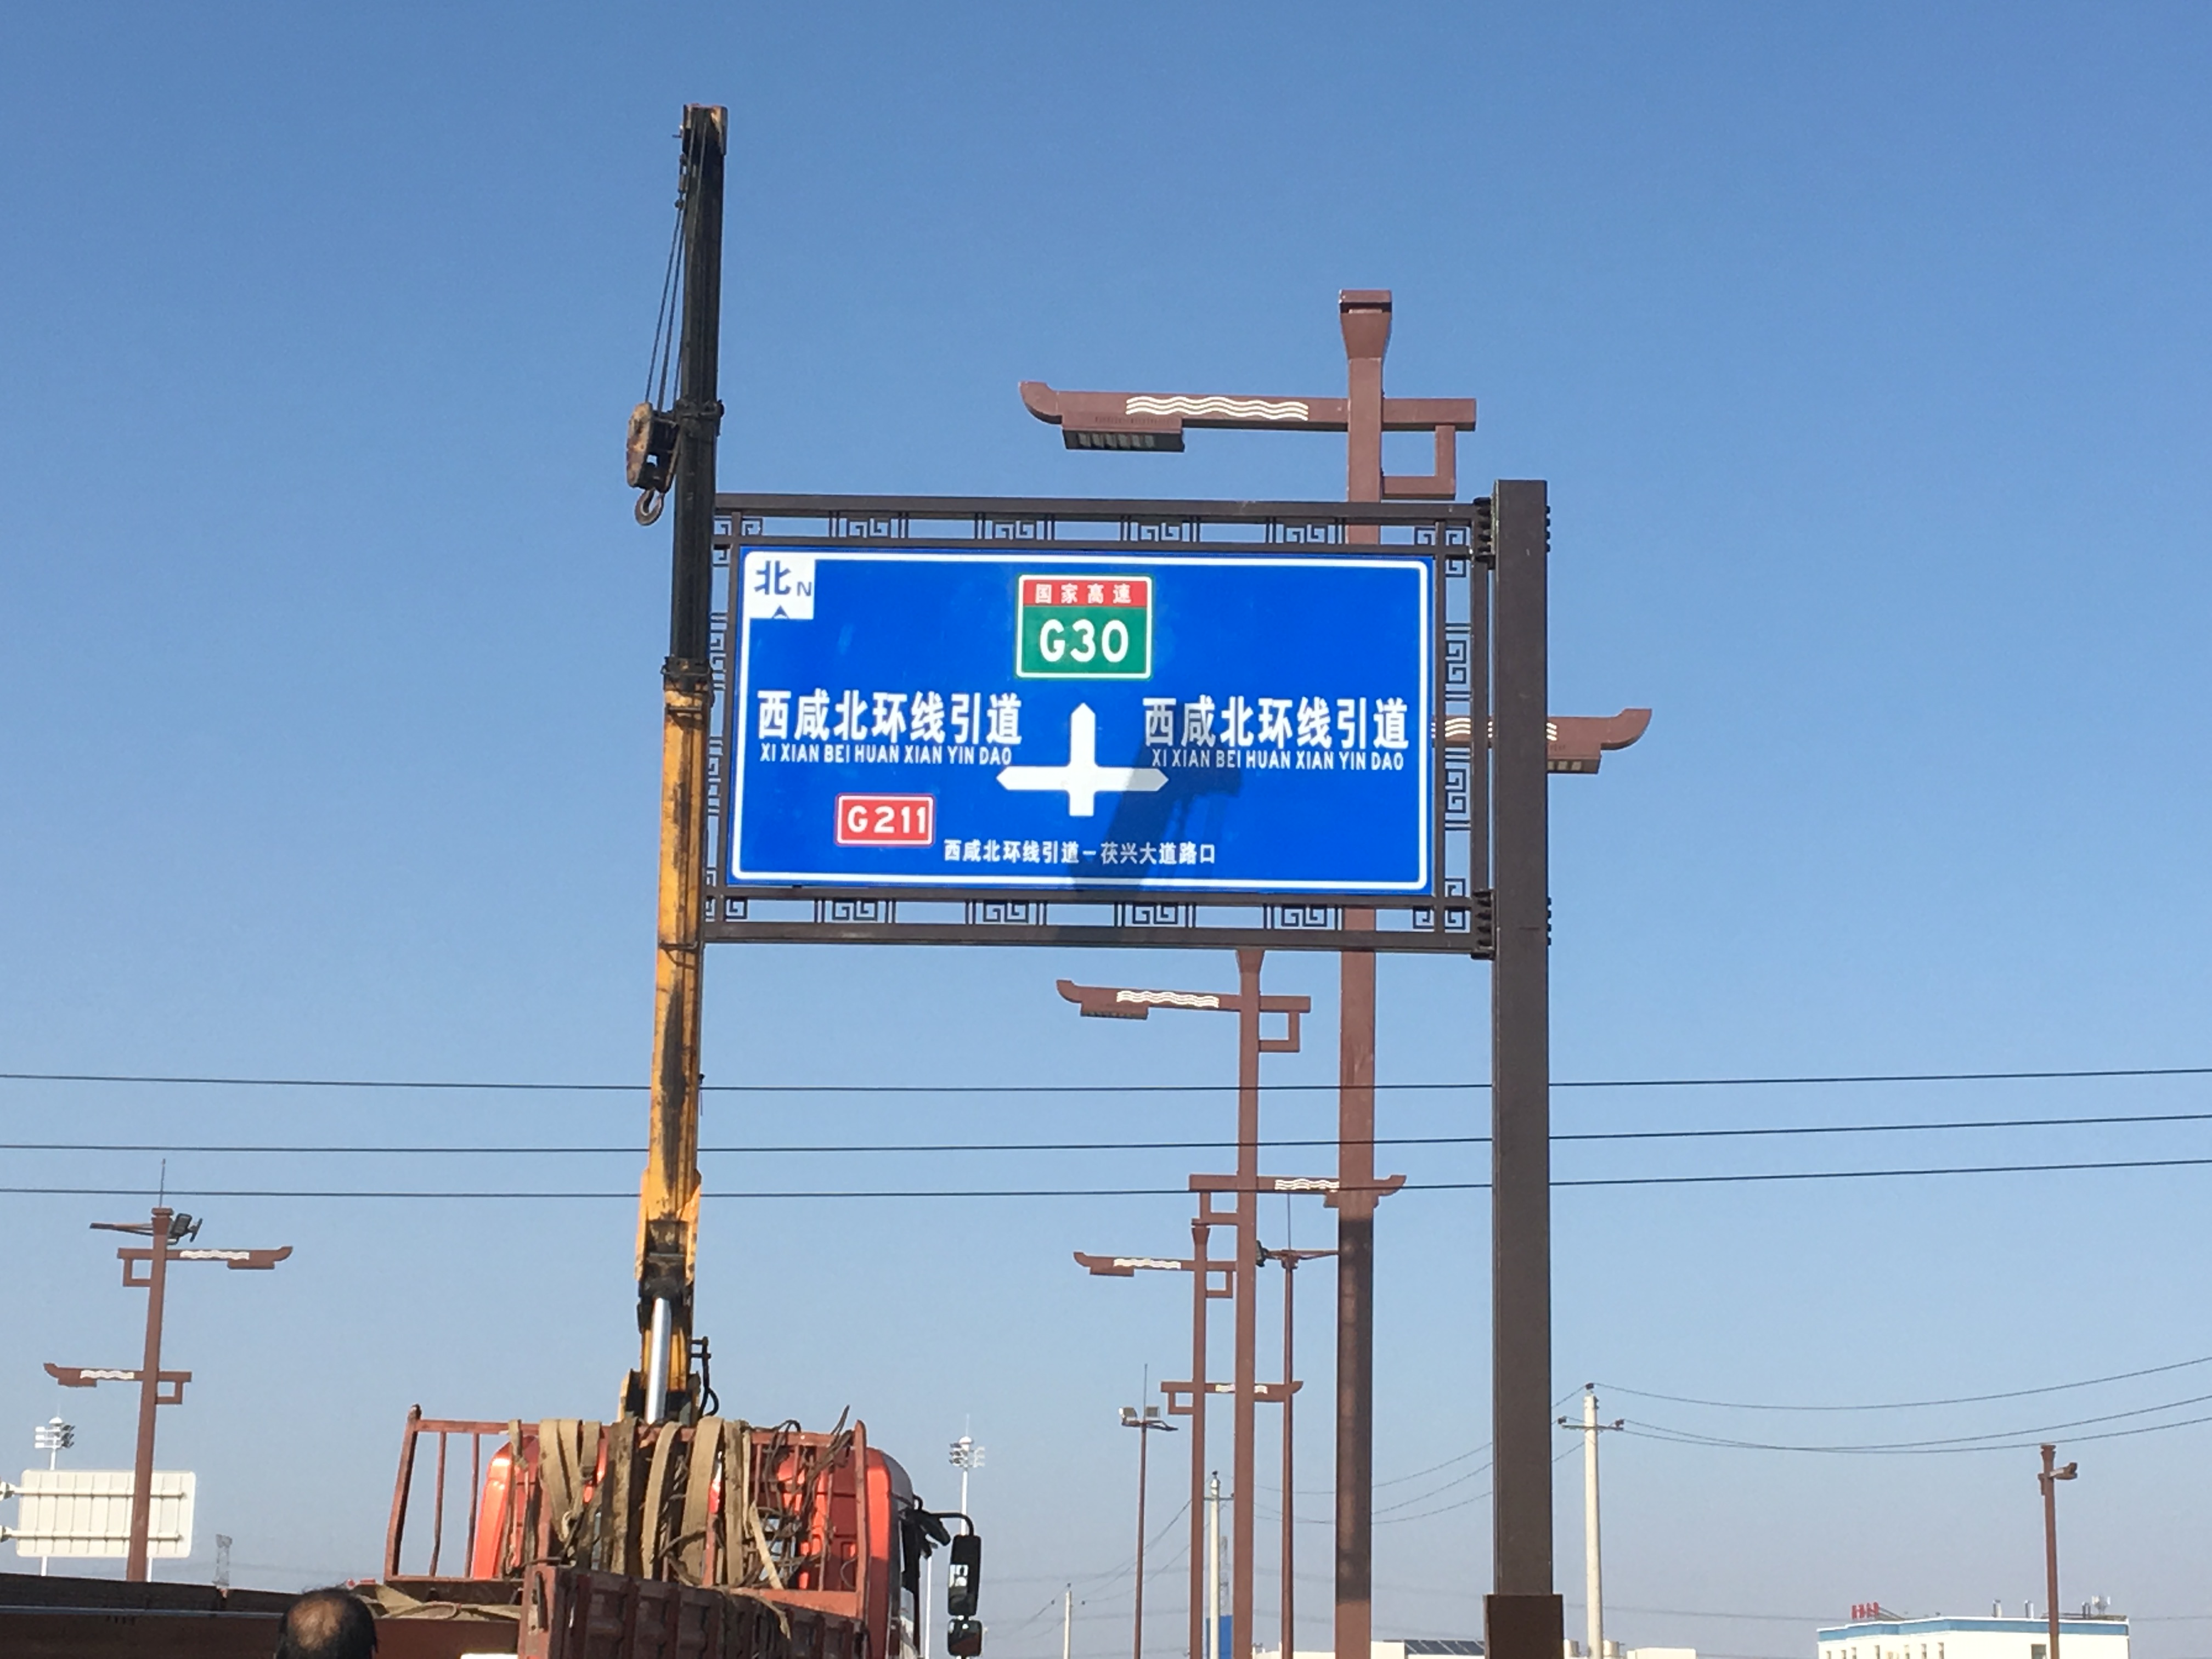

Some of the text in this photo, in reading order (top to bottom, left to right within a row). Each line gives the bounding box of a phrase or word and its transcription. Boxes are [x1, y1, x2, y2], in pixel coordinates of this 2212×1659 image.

[754, 560, 812, 597] 北 N
[1035, 583, 1131, 604] 国家高速
[1040, 619, 1128, 663] G30
[757, 688, 1022, 745] 西咸北环线引道
[1143, 695, 1409, 749] 西咸北环线引道
[760, 743, 1012, 765] XI XIAN BEI HUAN XIAN YIN DAO
[1152, 748, 1403, 771] XI XIAN BEI HUAN XIAN YIN DAO
[848, 805, 926, 834] G211
